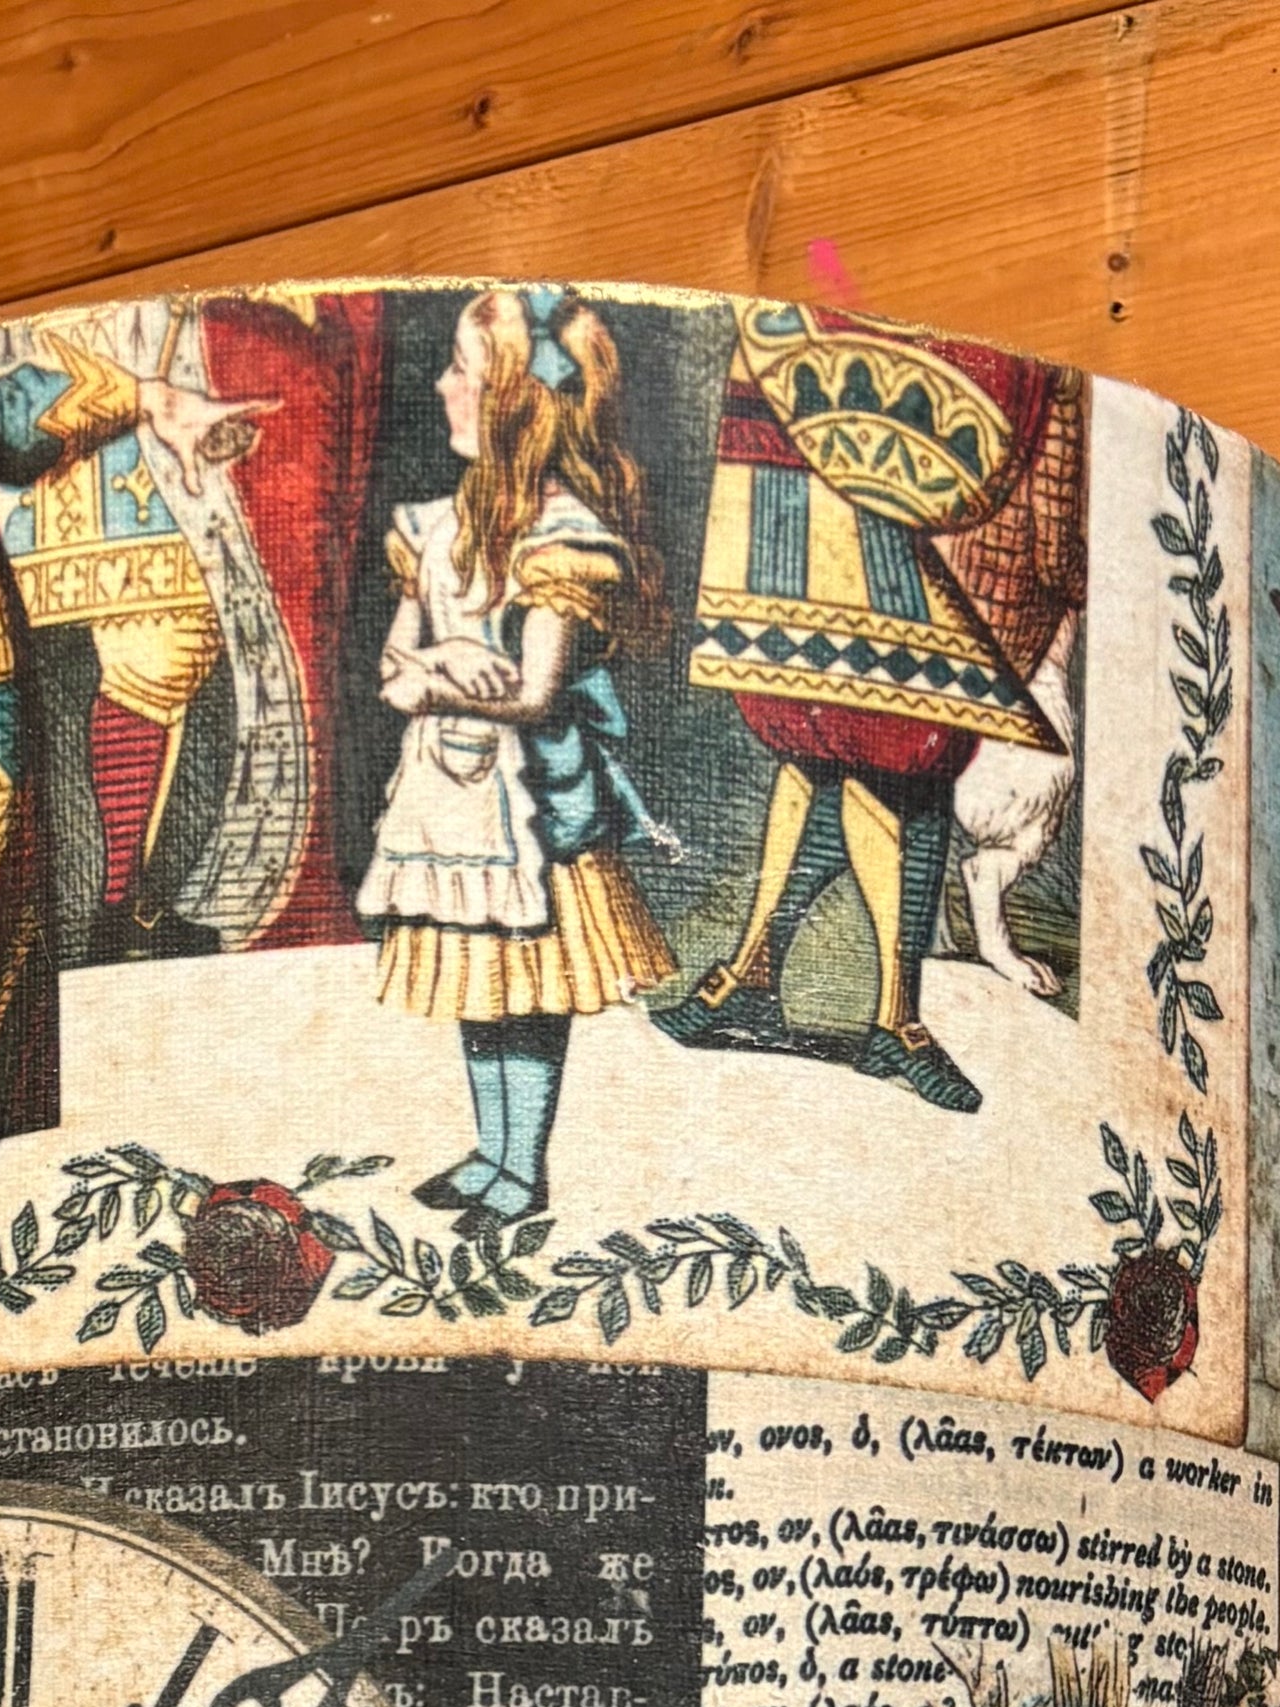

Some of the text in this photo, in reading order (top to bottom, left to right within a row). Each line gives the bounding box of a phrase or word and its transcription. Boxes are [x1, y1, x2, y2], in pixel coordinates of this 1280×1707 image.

[470, 1482, 542, 1512] кто
[556, 1482, 656, 1523] при-
[1167, 1456, 1242, 1497] worker
[1253, 1470, 1273, 1508] in
[598, 1551, 655, 1583] же
[1077, 1527, 1163, 1569] stirred
[1168, 1535, 1193, 1580] by
[1196, 1551, 1211, 1578] a
[1016, 1570, 1160, 1626] nourishing
[1166, 1582, 1199, 1619] the
[839, 1656, 860, 1682] a
